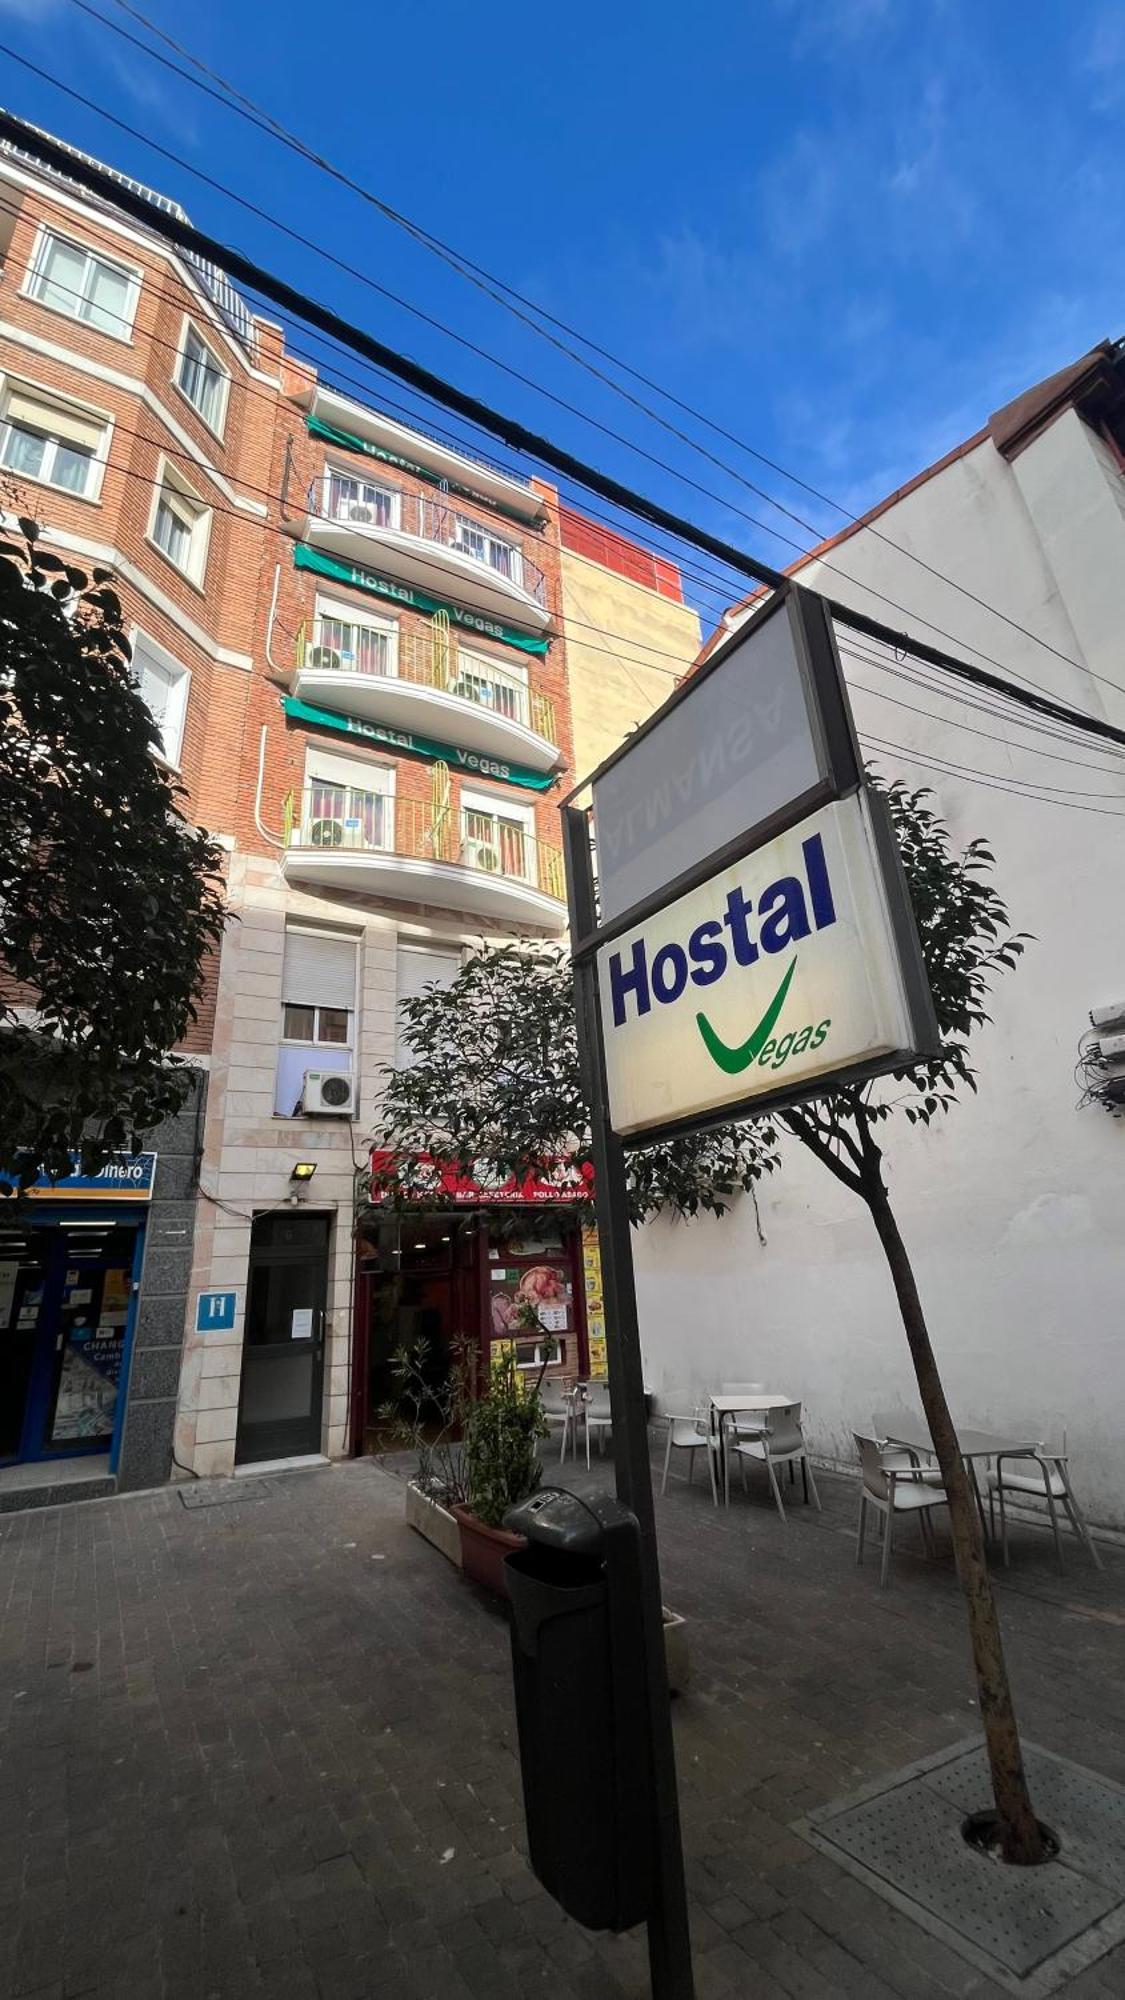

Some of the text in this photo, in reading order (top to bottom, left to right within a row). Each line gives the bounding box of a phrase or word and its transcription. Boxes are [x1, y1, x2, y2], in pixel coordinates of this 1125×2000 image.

[351, 566, 505, 638] Hostal Vegas
[347, 718, 511, 779] Hostal Vegas
[608, 832, 837, 1028] Hostal
[696, 953, 832, 1075] Vegas
